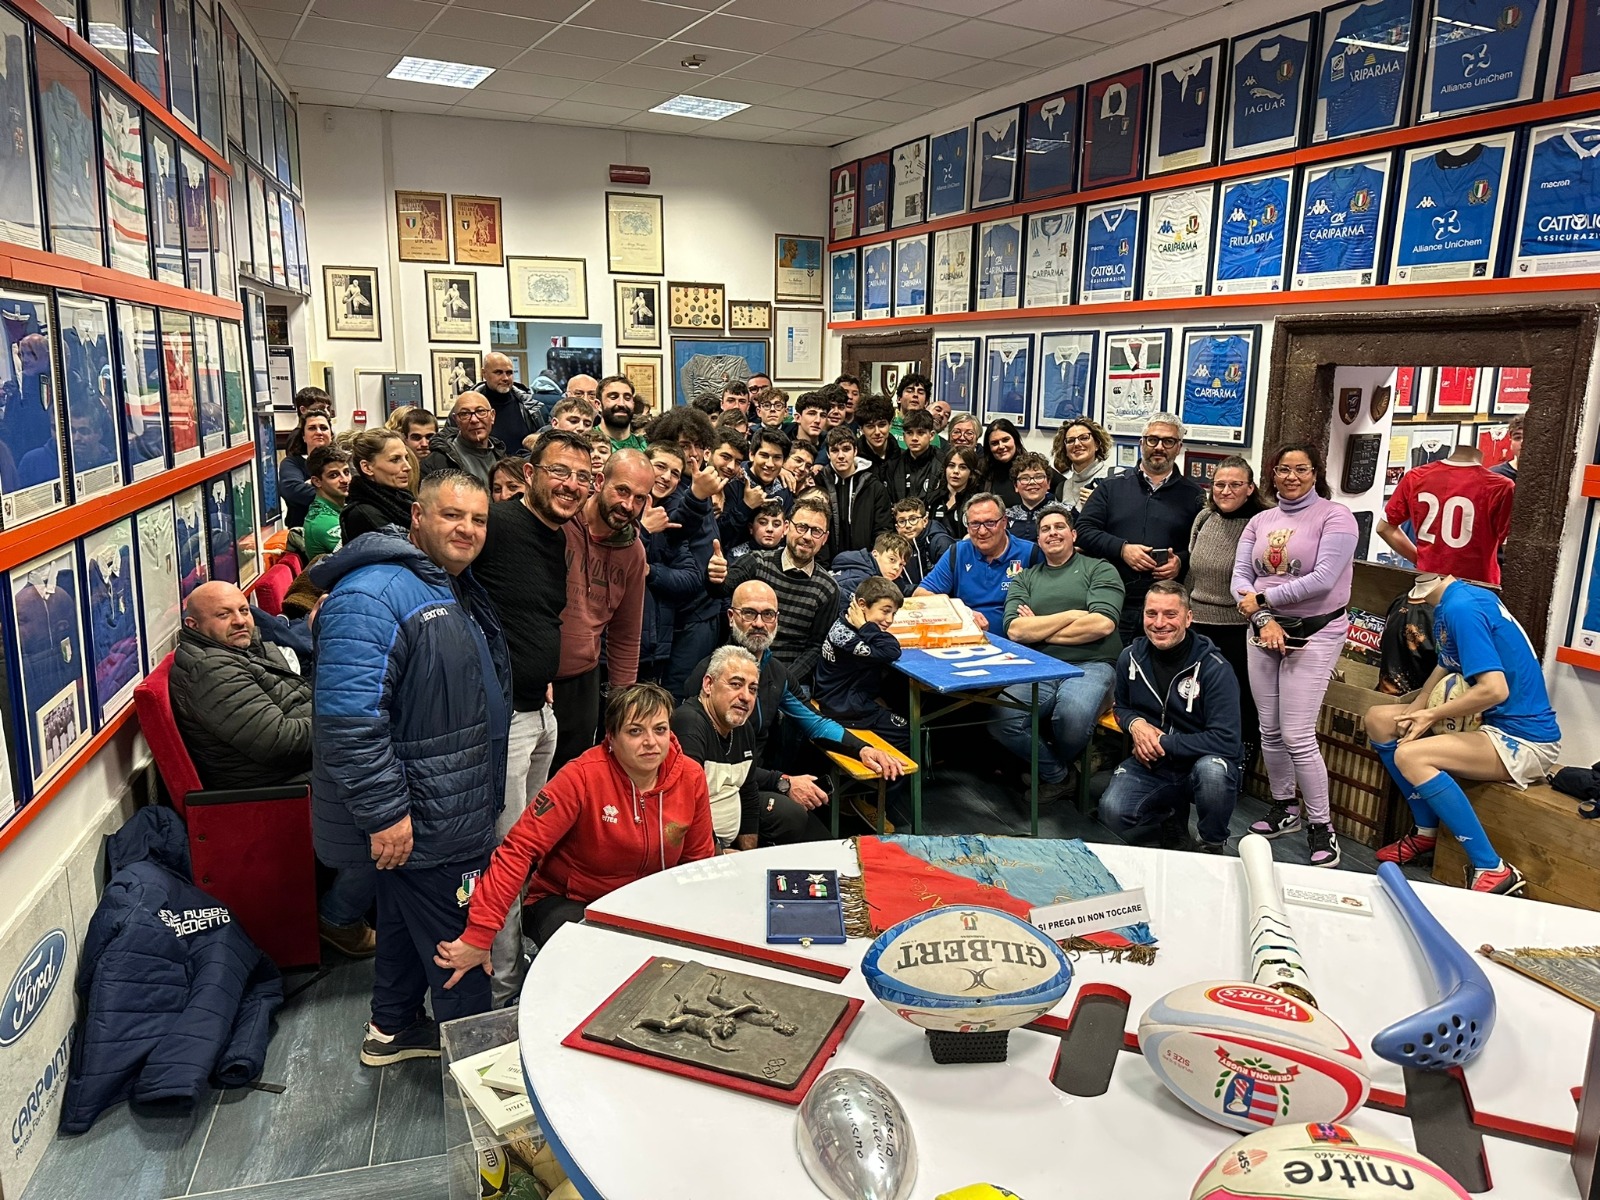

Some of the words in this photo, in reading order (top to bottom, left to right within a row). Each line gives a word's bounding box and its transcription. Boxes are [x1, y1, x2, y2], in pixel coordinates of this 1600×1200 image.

[1440, 78, 1473, 94] Alliance
[1474, 71, 1513, 87] UniChem
[1244, 98, 1286, 117] JAGUAR
[1541, 179, 1570, 189] macron
[1229, 231, 1274, 248] FRIULADRIA
[1309, 224, 1365, 241] CARIPARMA
[1537, 232, 1600, 242] ASSICURAZI
[1157, 241, 1198, 254] CARIPARMA
[1412, 243, 1443, 254] Alliance
[1444, 238, 1482, 250] UniChem
[984, 264, 1013, 275] CARIPARMA
[1032, 268, 1064, 278] CARIPARMA
[1090, 264, 1126, 278] CATTOLICA
[1194, 387, 1237, 398] CARIPARMA
[1416, 491, 1475, 549] 20
[183, 907, 229, 920] RUGBY
[1038, 923, 1046, 932] SI
[1048, 918, 1076, 930] PREGA
[1077, 916, 1086, 924] DI
[1088, 912, 1105, 922] NON
[1106, 904, 1142, 918] TOCCARE
[896, 939, 1047, 970] GILBERT
[13, 946, 54, 1031] Ford
[1222, 988, 1298, 1019] WITOR'S
[1172, 1052, 1190, 1066] SIZE
[1219, 1057, 1248, 1077] RUGBY
[1248, 1065, 1292, 1083] CREMONA
[15, 1128, 32, 1160] Pensa
[1343, 1152, 1370, 1161] MAX
[1283, 1159, 1415, 1191] mitre
